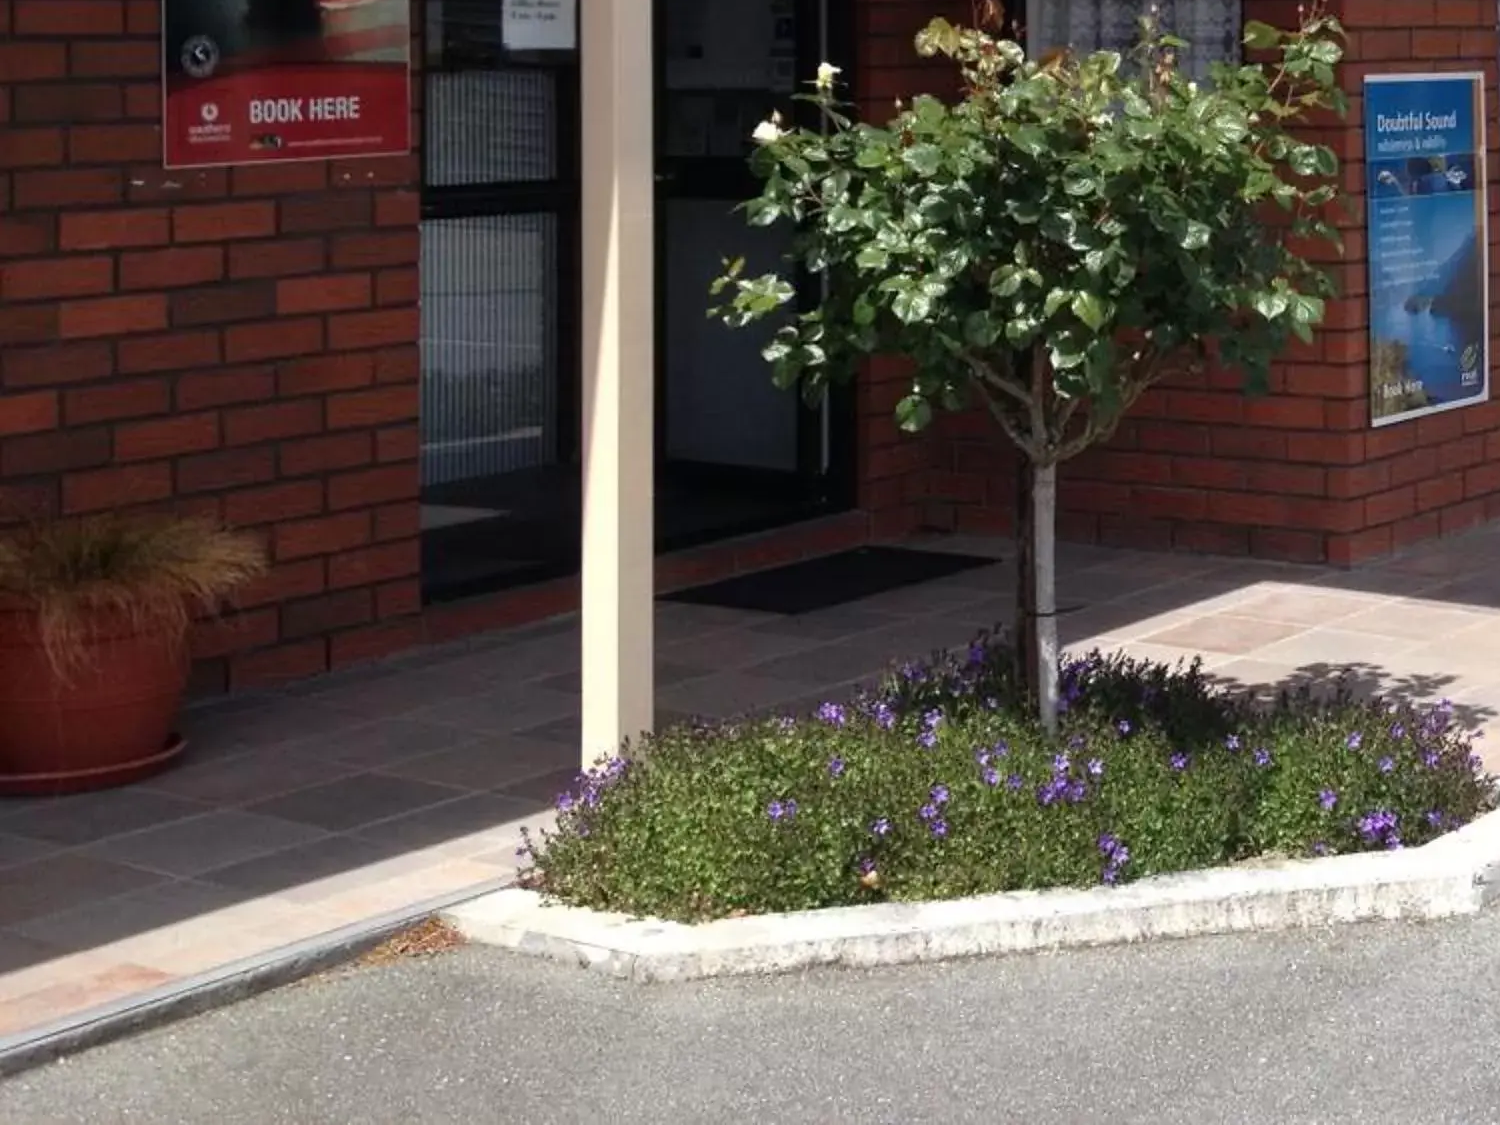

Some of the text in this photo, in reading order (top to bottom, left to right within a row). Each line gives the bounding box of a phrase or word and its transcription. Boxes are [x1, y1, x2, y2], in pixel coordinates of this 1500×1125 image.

[249, 96, 361, 124] BOOK HERE
[1377, 108, 1457, 132] Doubtful Sound
